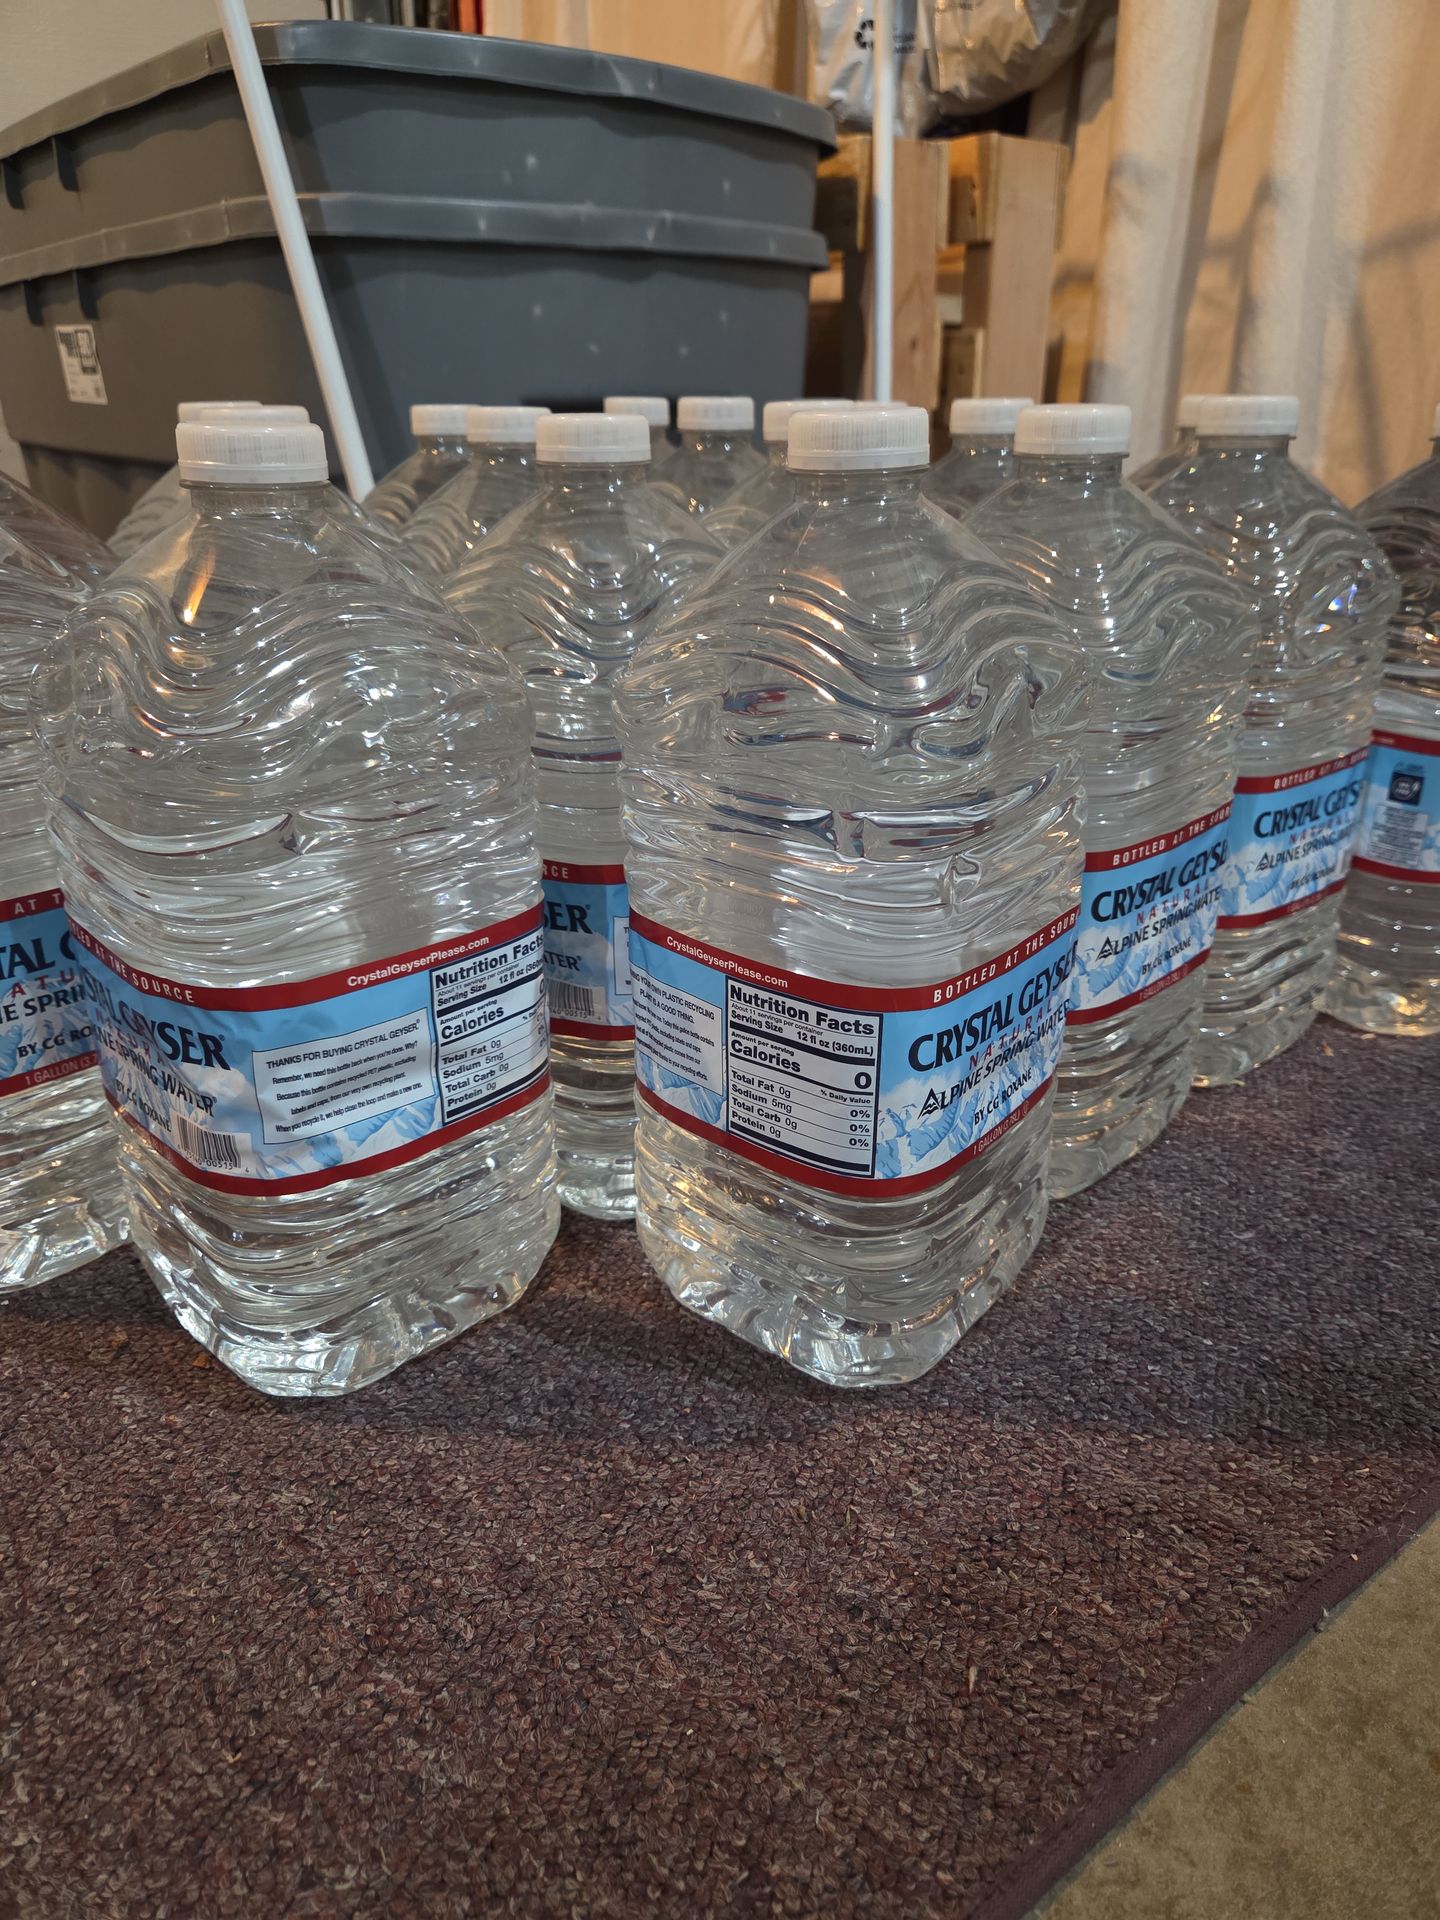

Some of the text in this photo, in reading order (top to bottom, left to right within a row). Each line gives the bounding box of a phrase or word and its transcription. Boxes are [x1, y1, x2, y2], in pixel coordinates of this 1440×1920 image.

[1254, 796, 1323, 838] CRYSTAL
[1113, 842, 1165, 866] BOTTLED
[1172, 831, 1184, 844] AT
[1189, 820, 1205, 838] THE
[1255, 844, 1300, 871] ALPINE
[14, 898, 37, 915] AT
[1091, 867, 1175, 922] CRYSTAL
[1096, 924, 1149, 962] ALPINE
[1152, 905, 1193, 938] SPRING
[347, 936, 489, 986] CrystalGeyserPlease.com
[436, 952, 508, 988] Nutrition
[667, 936, 788, 988] CrystalGeyserPlease.com
[934, 964, 996, 1003] BOTTLED
[1005, 951, 1019, 969] AT
[1026, 934, 1044, 955] THE
[109, 956, 194, 1003] THE SOURCE
[437, 991, 468, 1007] Serving
[470, 983, 487, 994] Size
[499, 974, 508, 984] 12
[509, 971, 515, 980] fl
[438, 986, 456, 997] About
[464, 975, 486, 988] servings
[487, 972, 496, 980] per
[497, 963, 520, 976] container
[440, 1010, 464, 1025] Amount
[477, 1000, 498, 1010] serving
[661, 1002, 676, 1017] GOOD
[677, 1010, 695, 1024] THING.
[662, 990, 684, 1006] PLASTIC
[684, 1000, 715, 1020] RECYCLING
[730, 984, 874, 1035] Nutrition Facts
[731, 1003, 749, 1014] About
[758, 1011, 782, 1024] servings
[784, 1019, 794, 1027] per
[795, 1022, 824, 1036] container
[442, 1007, 504, 1039] Calories
[731, 1010, 874, 1057] Serving Size 12 fl oz (360mL)
[908, 993, 1014, 1072] CRYSTAL
[969, 1000, 1051, 1070] NATURAL
[16, 1034, 65, 1058] BY CG
[266, 1034, 388, 1069] THANKS FOR BUYING CRYSTAL
[442, 1040, 501, 1065] Total Fat 0g
[731, 1031, 795, 1057] Amount per serving
[34, 1062, 78, 1082] GALLON
[313, 1069, 326, 1077] need
[327, 1066, 336, 1075] this
[337, 1062, 350, 1071] bottle
[351, 1060, 362, 1068] back
[363, 1055, 376, 1063] when
[443, 1052, 504, 1079] Sodium 5mg
[445, 1062, 509, 1093] Total Carb 0g
[731, 1040, 872, 1089] Calories 0
[917, 1067, 983, 1120] ALPINE
[984, 1028, 1036, 1078] SPRING
[276, 1092, 300, 1101] Because
[312, 1085, 326, 1094] bottle
[327, 1080, 346, 1090] contains
[333, 1107, 344, 1117] help
[366, 1098, 377, 1106] loop
[447, 1082, 496, 1107] Protein 0g
[731, 1070, 870, 1119] Total Fat 0g 0%
[829, 1092, 848, 1103] Daily
[849, 1096, 871, 1104] Value
[974, 1068, 1032, 1125] BY CG ROXANE
[291, 1106, 306, 1115] labels
[731, 1084, 870, 1133] Sodium 5mg 0%
[732, 1097, 869, 1148] Total Carb 0g 0%
[732, 1110, 781, 1138] Protein 0g
[978, 1126, 1003, 1152] GALLON
